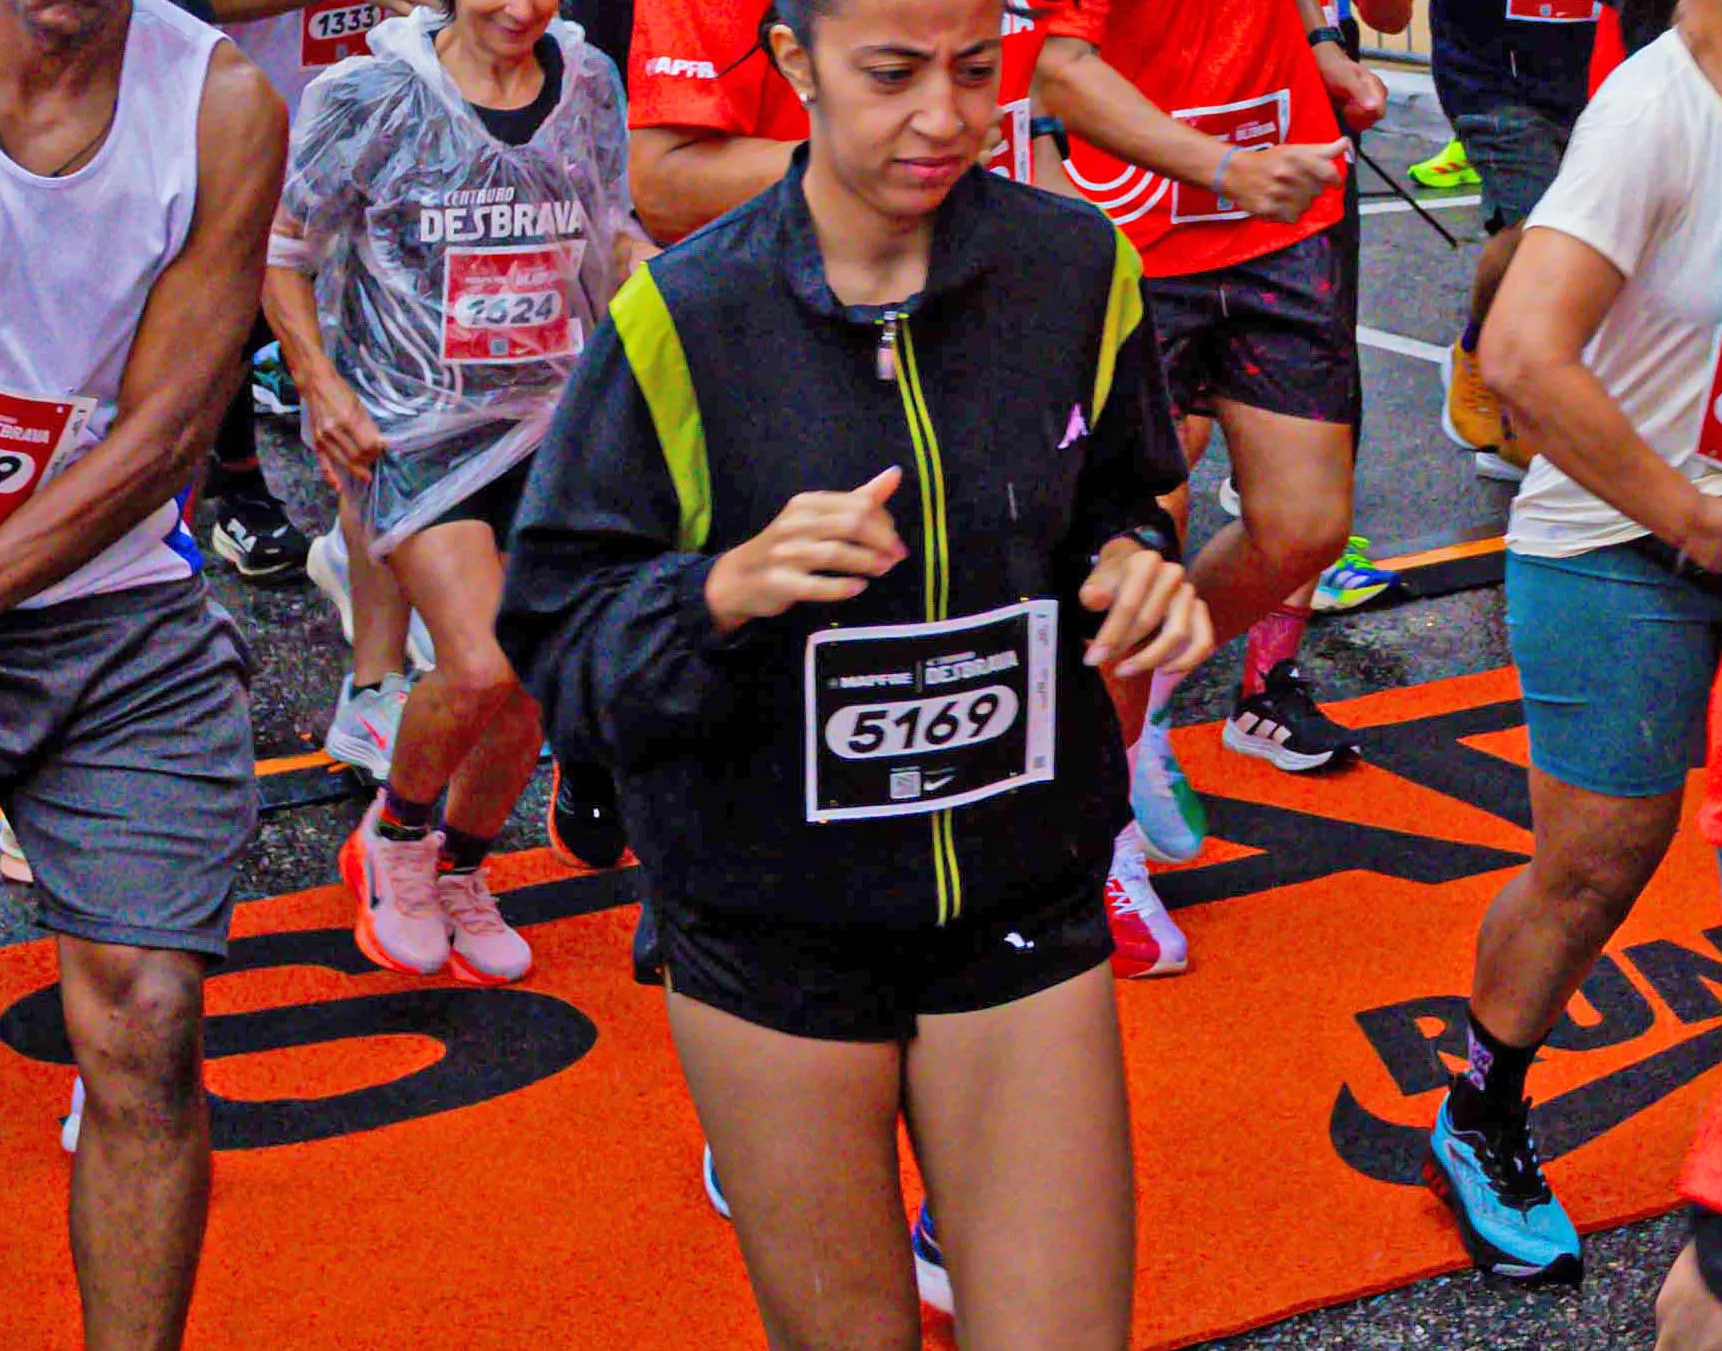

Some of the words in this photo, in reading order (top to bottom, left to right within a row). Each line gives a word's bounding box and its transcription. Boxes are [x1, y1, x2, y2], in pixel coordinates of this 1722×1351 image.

[318, 4, 376, 37] 1333
[420, 200, 583, 243] DESBRAVA
[847, 693, 1000, 754] 5169
